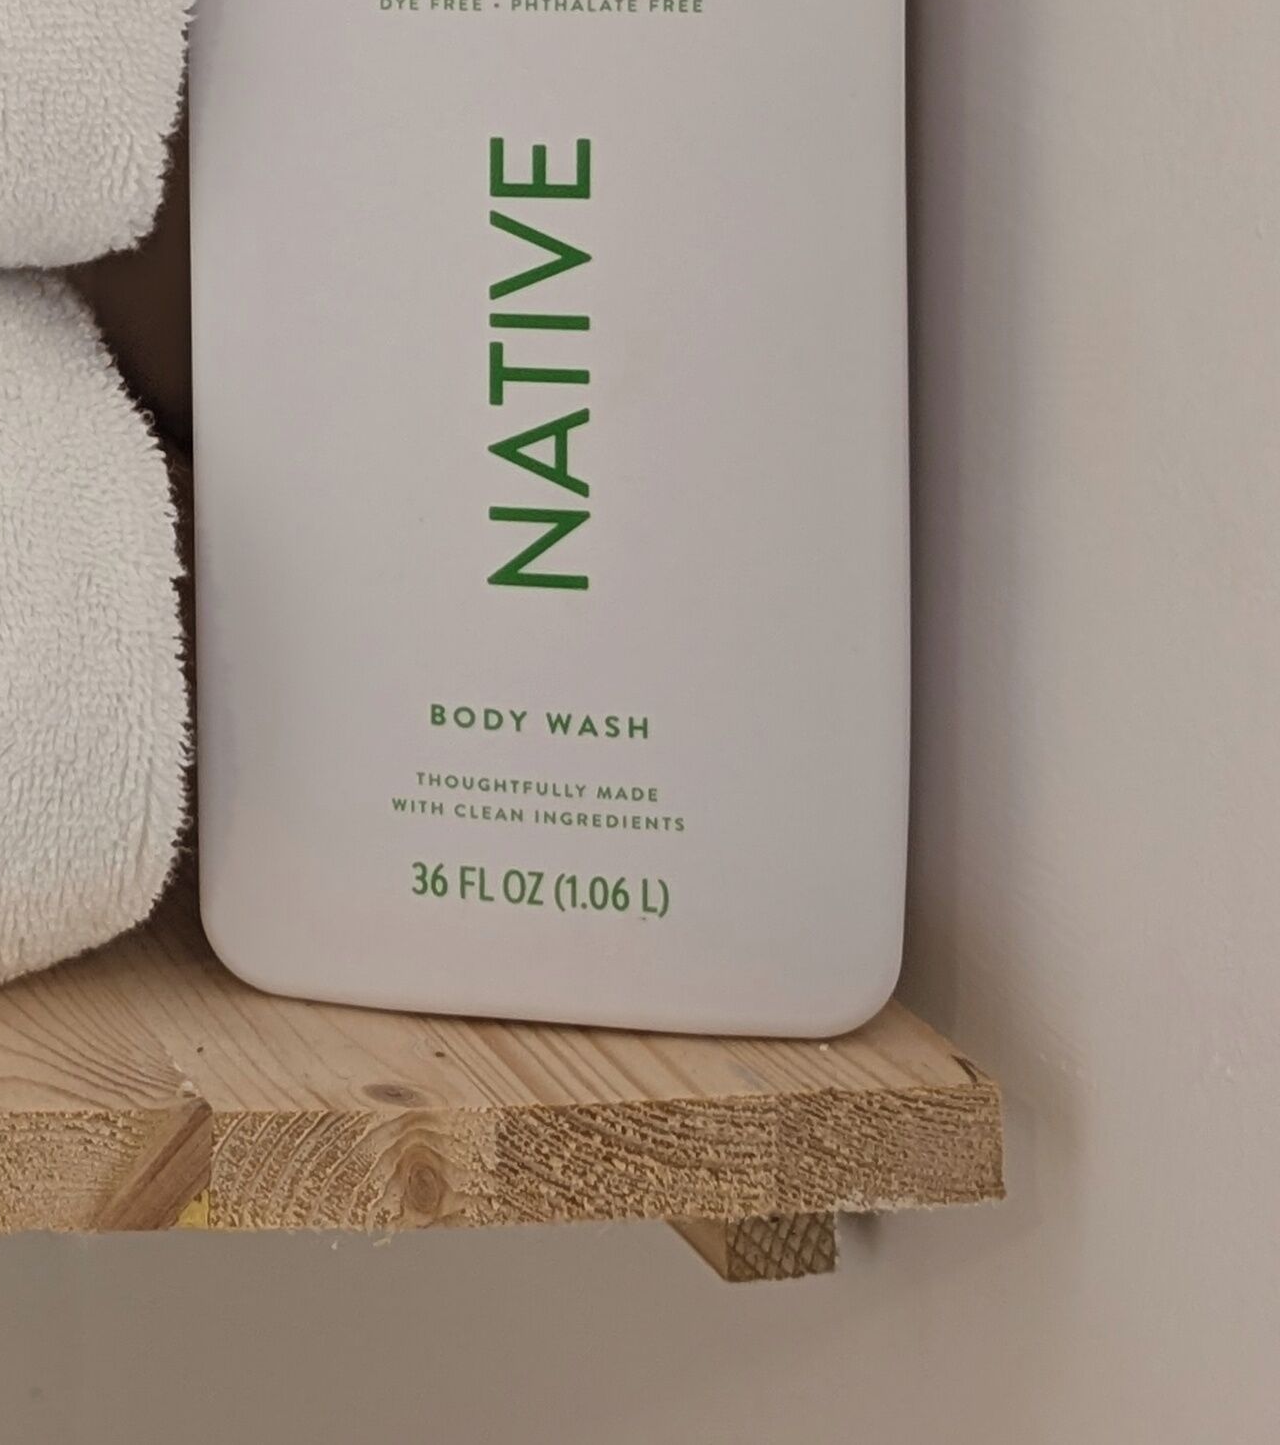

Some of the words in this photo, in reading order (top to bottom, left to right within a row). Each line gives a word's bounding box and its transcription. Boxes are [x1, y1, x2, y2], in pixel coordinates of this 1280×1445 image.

[486, 137, 593, 591] NATIVE
[430, 703, 528, 733] BODY
[545, 712, 649, 740] WASH
[415, 771, 587, 799] THOUGHTFULLY
[596, 785, 658, 803] MADE
[391, 797, 444, 816] WITH
[453, 803, 524, 823] CLEAN
[534, 809, 685, 832] INGREDIENTS
[411, 861, 449, 898] 36
[459, 865, 495, 902] FL
[502, 869, 545, 906] OZ
[554, 873, 630, 913] (1.06
[641, 877, 670, 917] L)
